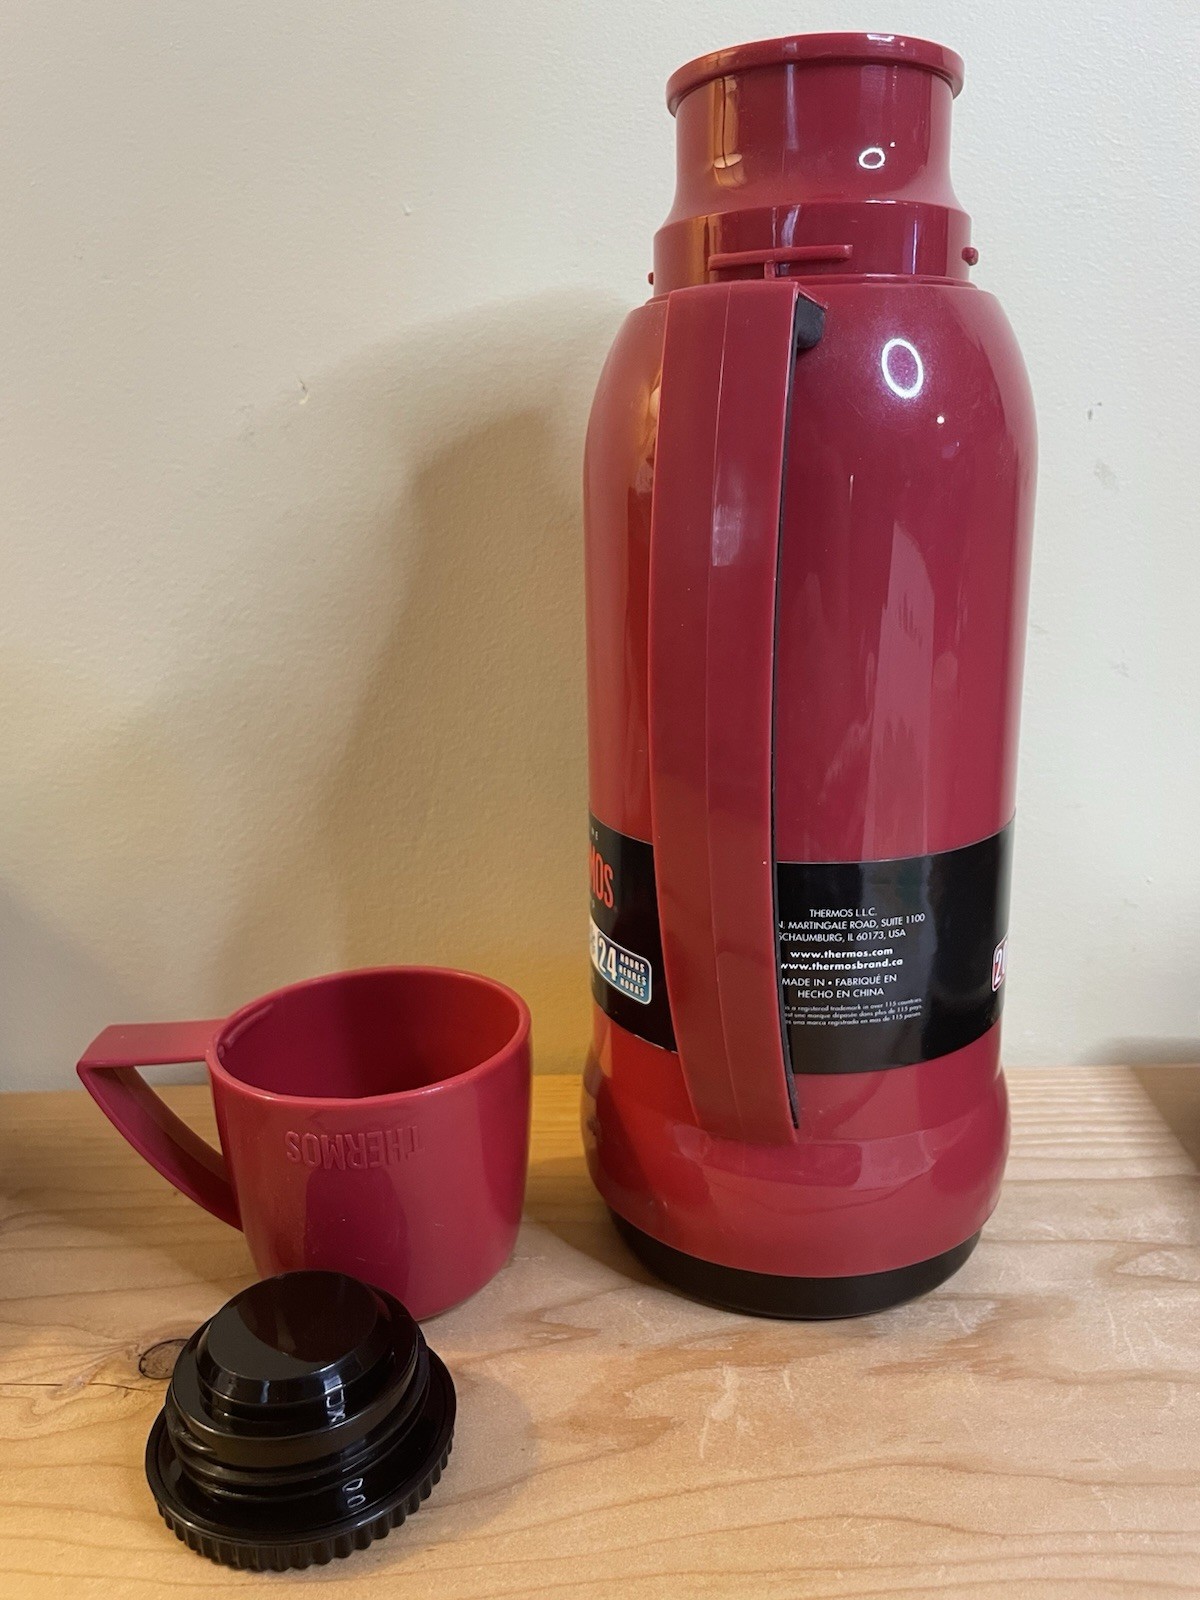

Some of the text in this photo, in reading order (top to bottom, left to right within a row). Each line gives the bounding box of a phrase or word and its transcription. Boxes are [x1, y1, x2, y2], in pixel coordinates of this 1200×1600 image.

[810, 909, 853, 918] THERMOS
[788, 921, 847, 930] MARTINGALE
[850, 920, 879, 929] ROAD,
[881, 917, 903, 927] SUITE
[906, 913, 925, 924] 1100
[848, 933, 854, 942] IL
[856, 931, 886, 941] 60173,
[889, 929, 906, 938] USA
[790, 948, 893, 958] www.thermos.com
[599, 938, 617, 981] 24
[620, 953, 645, 973] HOURS
[781, 958, 903, 970] www.thermosbrand.ca
[782, 974, 897, 987] MADE IN FABRIQUÉ EN
[621, 978, 645, 997] HORAS
[797, 988, 885, 999] HECHO EN CHINA
[798, 1005, 829, 1013] registered
[831, 1004, 861, 1012] trademark
[875, 1009, 887, 1017] plus
[828, 1019, 859, 1027] registrada
[285, 1126, 425, 1171] THERMOS
